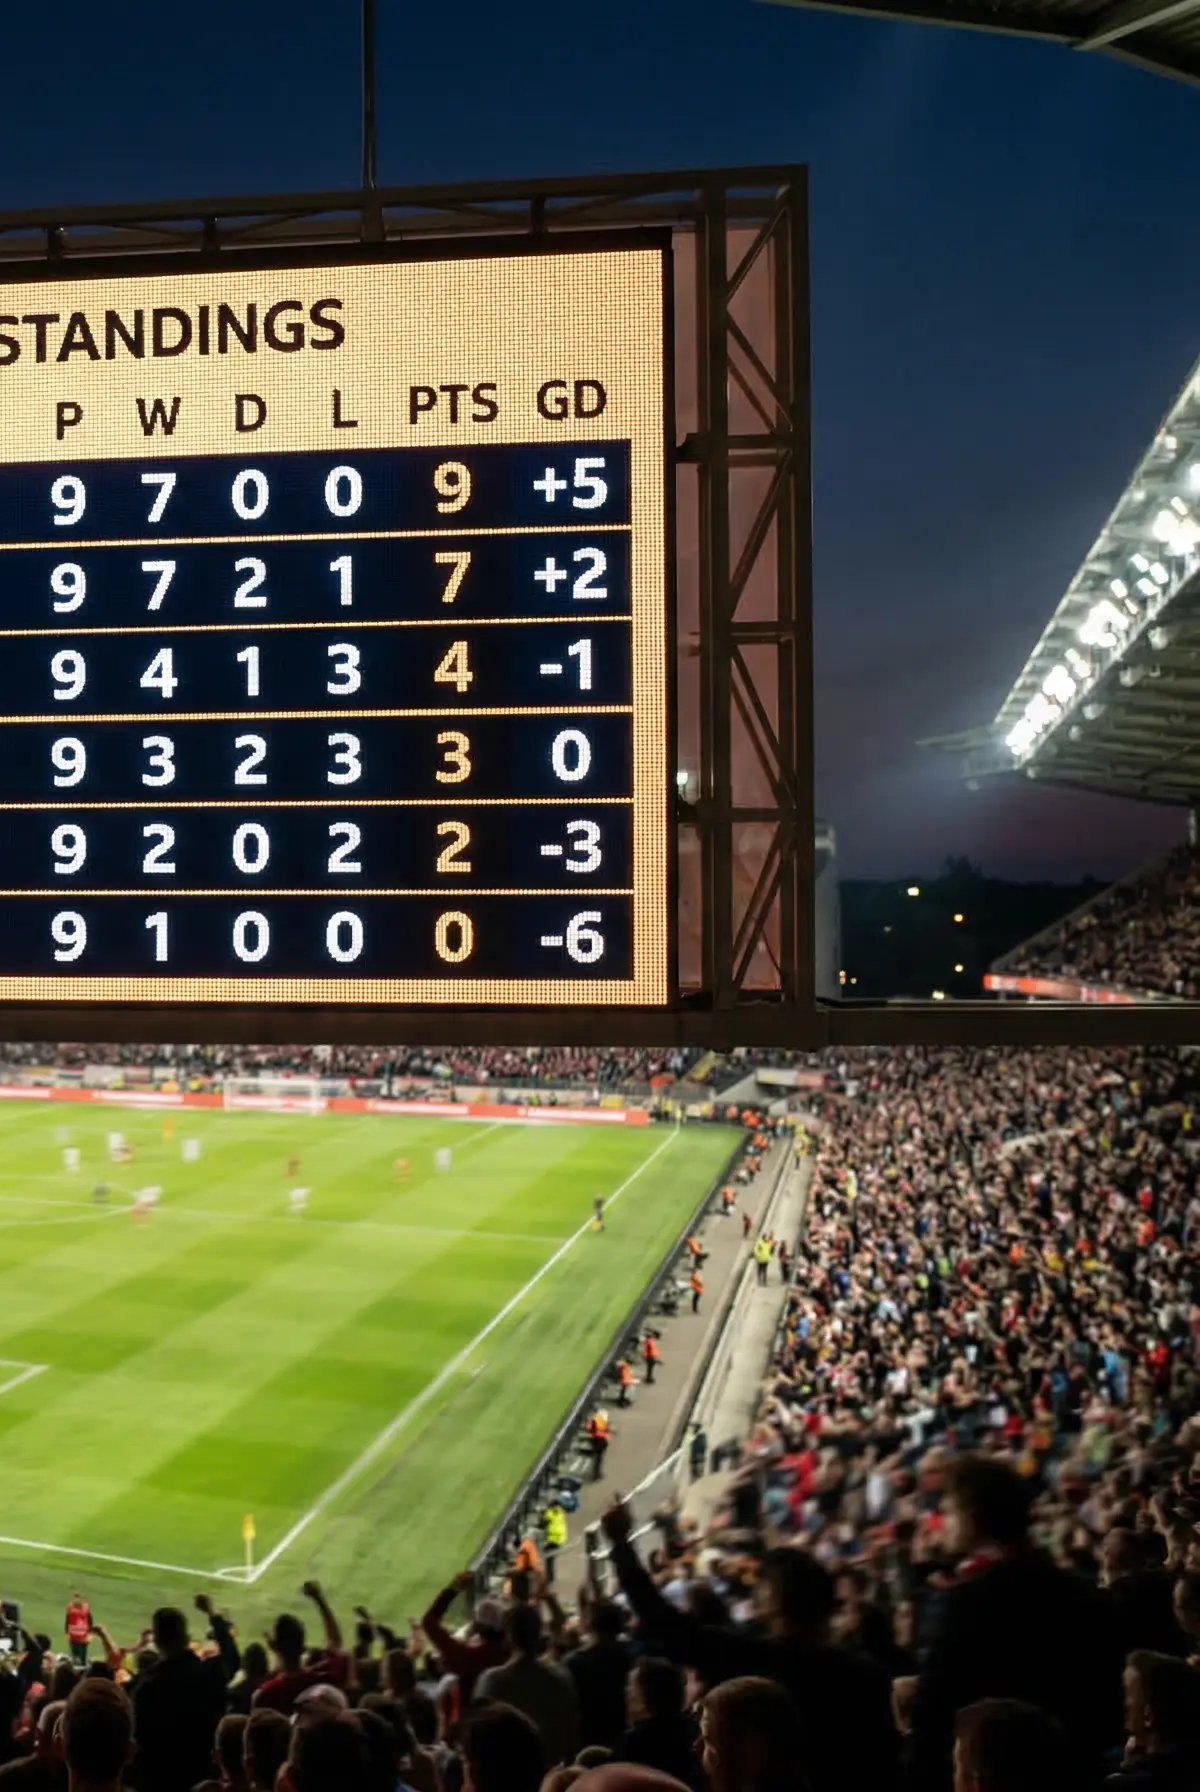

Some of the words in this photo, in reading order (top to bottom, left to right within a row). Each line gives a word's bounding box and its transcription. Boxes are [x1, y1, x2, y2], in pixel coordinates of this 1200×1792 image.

[56, 401, 84, 441] P
[135, 396, 182, 437] W
[234, 393, 267, 433] D
[331, 388, 359, 429] L
[409, 382, 500, 425] PTS
[536, 379, 608, 422] GD
[50, 474, 87, 526] 9
[140, 472, 177, 523] 7
[231, 468, 270, 521] 0
[324, 465, 363, 517] 0
[433, 460, 472, 514] 9
[532, 456, 608, 510] +5
[50, 562, 87, 613] 9
[141, 559, 177, 611] 7
[233, 556, 268, 608] 2
[329, 555, 353, 606] 1
[434, 551, 472, 603] 7
[533, 546, 608, 600] +2
[50, 649, 87, 701] 9
[139, 647, 179, 699] 4
[236, 645, 260, 697] 1
[326, 642, 362, 695] 3
[433, 640, 474, 693] 4
[539, 638, 592, 691] -1
[50, 736, 87, 788] 9
[141, 735, 176, 787] 3
[234, 733, 268, 785] 2
[327, 732, 362, 786] 3
[435, 730, 472, 784] 3
[551, 729, 592, 782] 0
[50, 823, 87, 875] 9
[142, 823, 176, 874] 2
[232, 822, 270, 874] 0
[327, 821, 362, 873] 2
[436, 820, 472, 873] 2
[540, 819, 602, 873] -3
[50, 910, 88, 962] 9
[144, 911, 169, 962] 1
[232, 910, 270, 963] 0
[325, 910, 364, 963] 0
[434, 910, 474, 963] 0
[540, 910, 605, 964] -6
